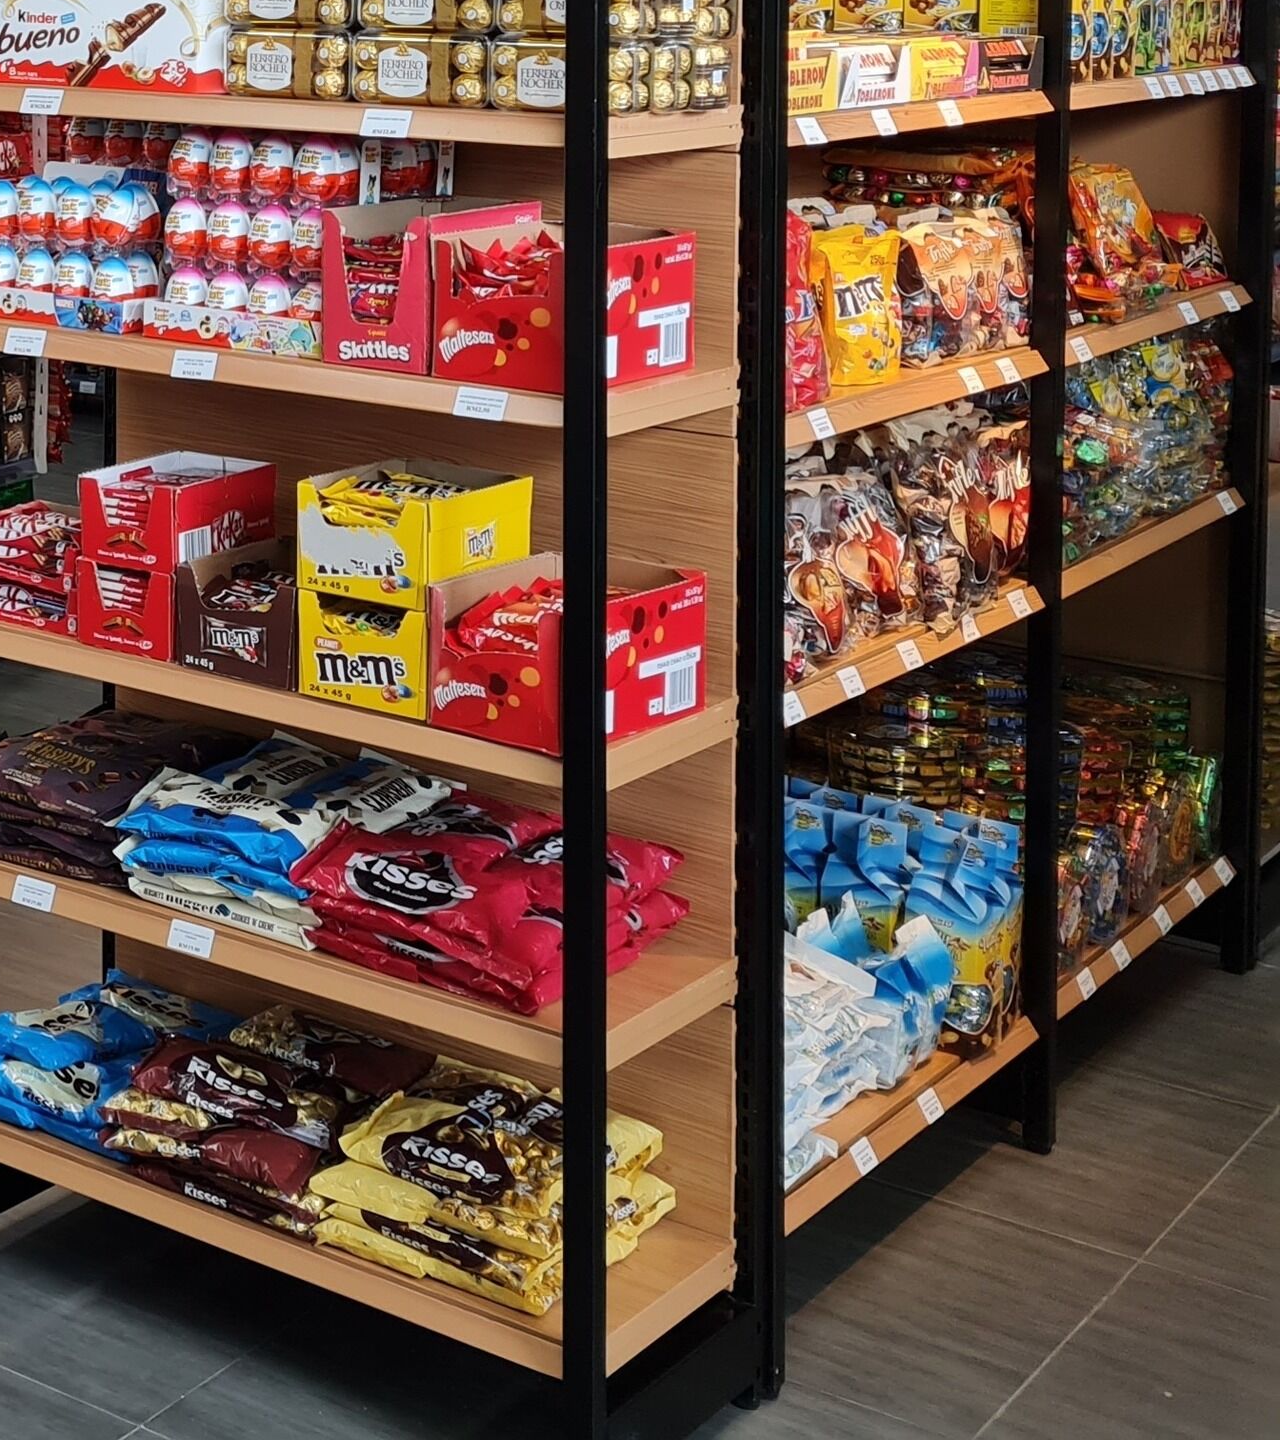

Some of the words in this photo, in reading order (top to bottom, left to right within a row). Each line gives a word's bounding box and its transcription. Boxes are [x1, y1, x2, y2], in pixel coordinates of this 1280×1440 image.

[18, 10, 57, 24] Kinder
[339, 341, 409, 361] Skittles
[439, 331, 495, 363] Maltesers
[308, 577, 319, 586] 24
[330, 581, 341, 591] 45
[309, 684, 320, 693] 24
[331, 689, 342, 698] 45
[434, 680, 486, 710] Maltesers
[165, 892, 223, 918] nuggets
